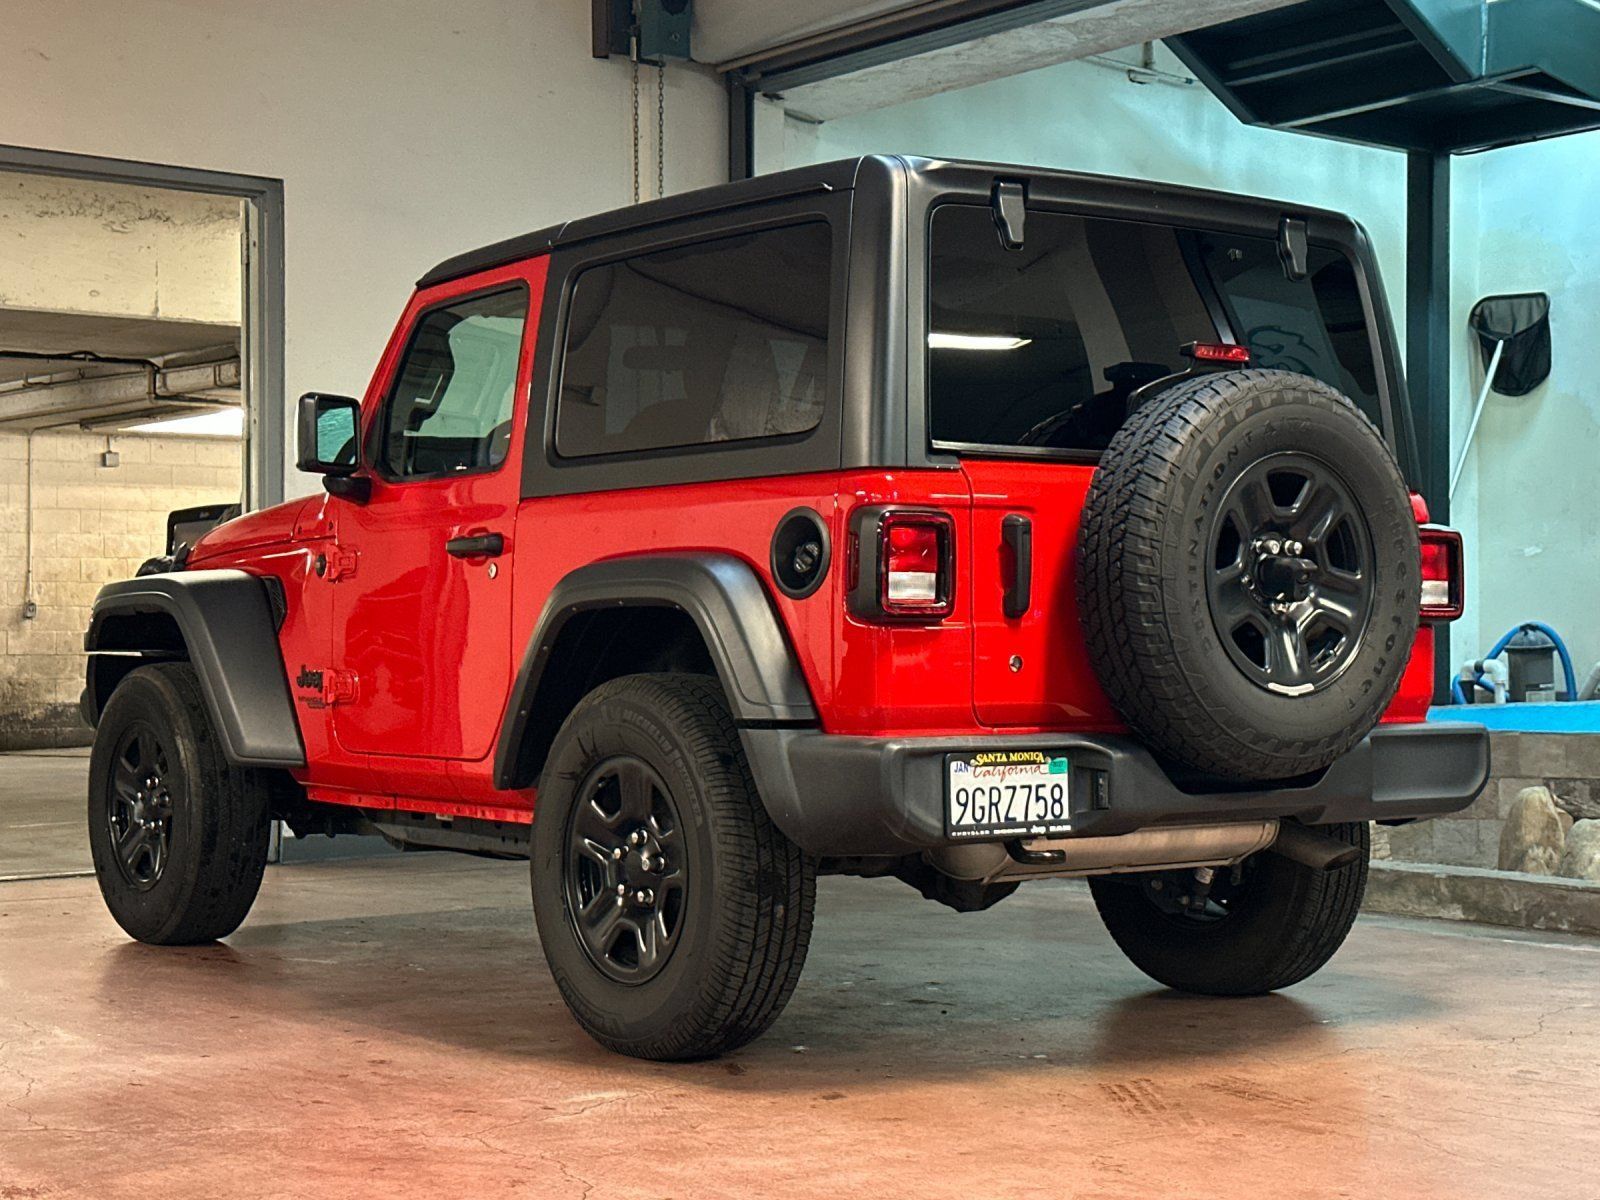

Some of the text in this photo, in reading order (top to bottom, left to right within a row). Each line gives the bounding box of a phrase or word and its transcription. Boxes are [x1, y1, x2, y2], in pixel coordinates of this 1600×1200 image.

[976, 752, 1045, 766] SANTA MONICA
[954, 762, 969, 773] JAN
[972, 765, 1049, 783] California
[956, 783, 1063, 825] 9GRZ758
